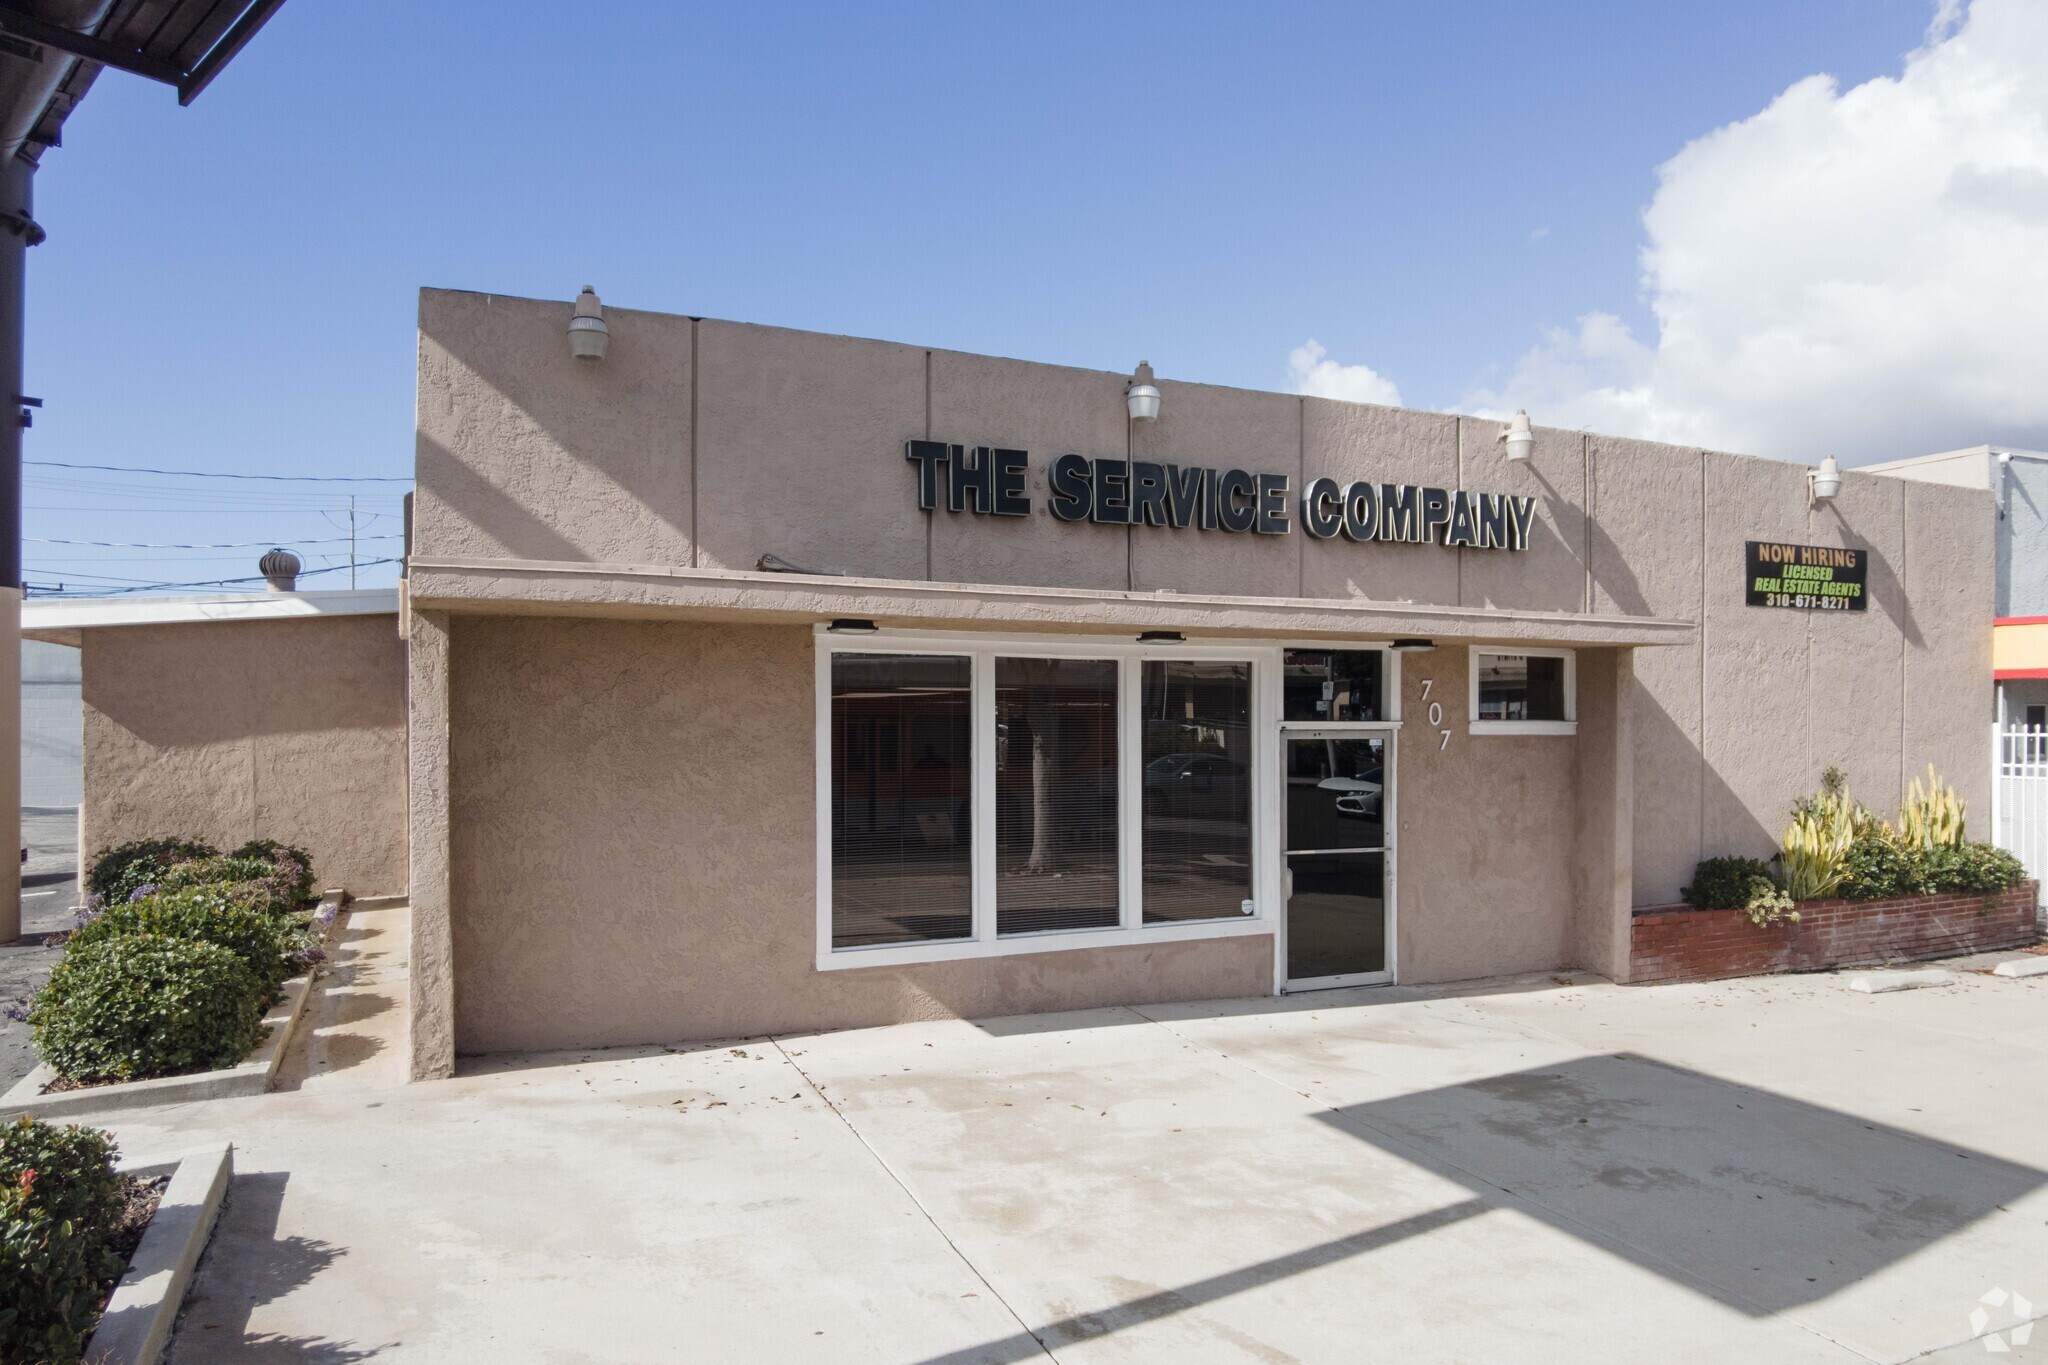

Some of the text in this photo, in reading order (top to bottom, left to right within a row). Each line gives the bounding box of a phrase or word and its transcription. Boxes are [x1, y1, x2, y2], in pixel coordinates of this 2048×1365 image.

[906, 440, 1537, 551] THE SERVICE COMPANY
[1759, 544, 1855, 567] NOW HIRING
[1783, 564, 1833, 580] LICENSED
[1754, 577, 1861, 596] REAL ESTATE AGENTS
[1767, 593, 1849, 609] 310-671-8271
[1421, 679, 1451, 750] 707
